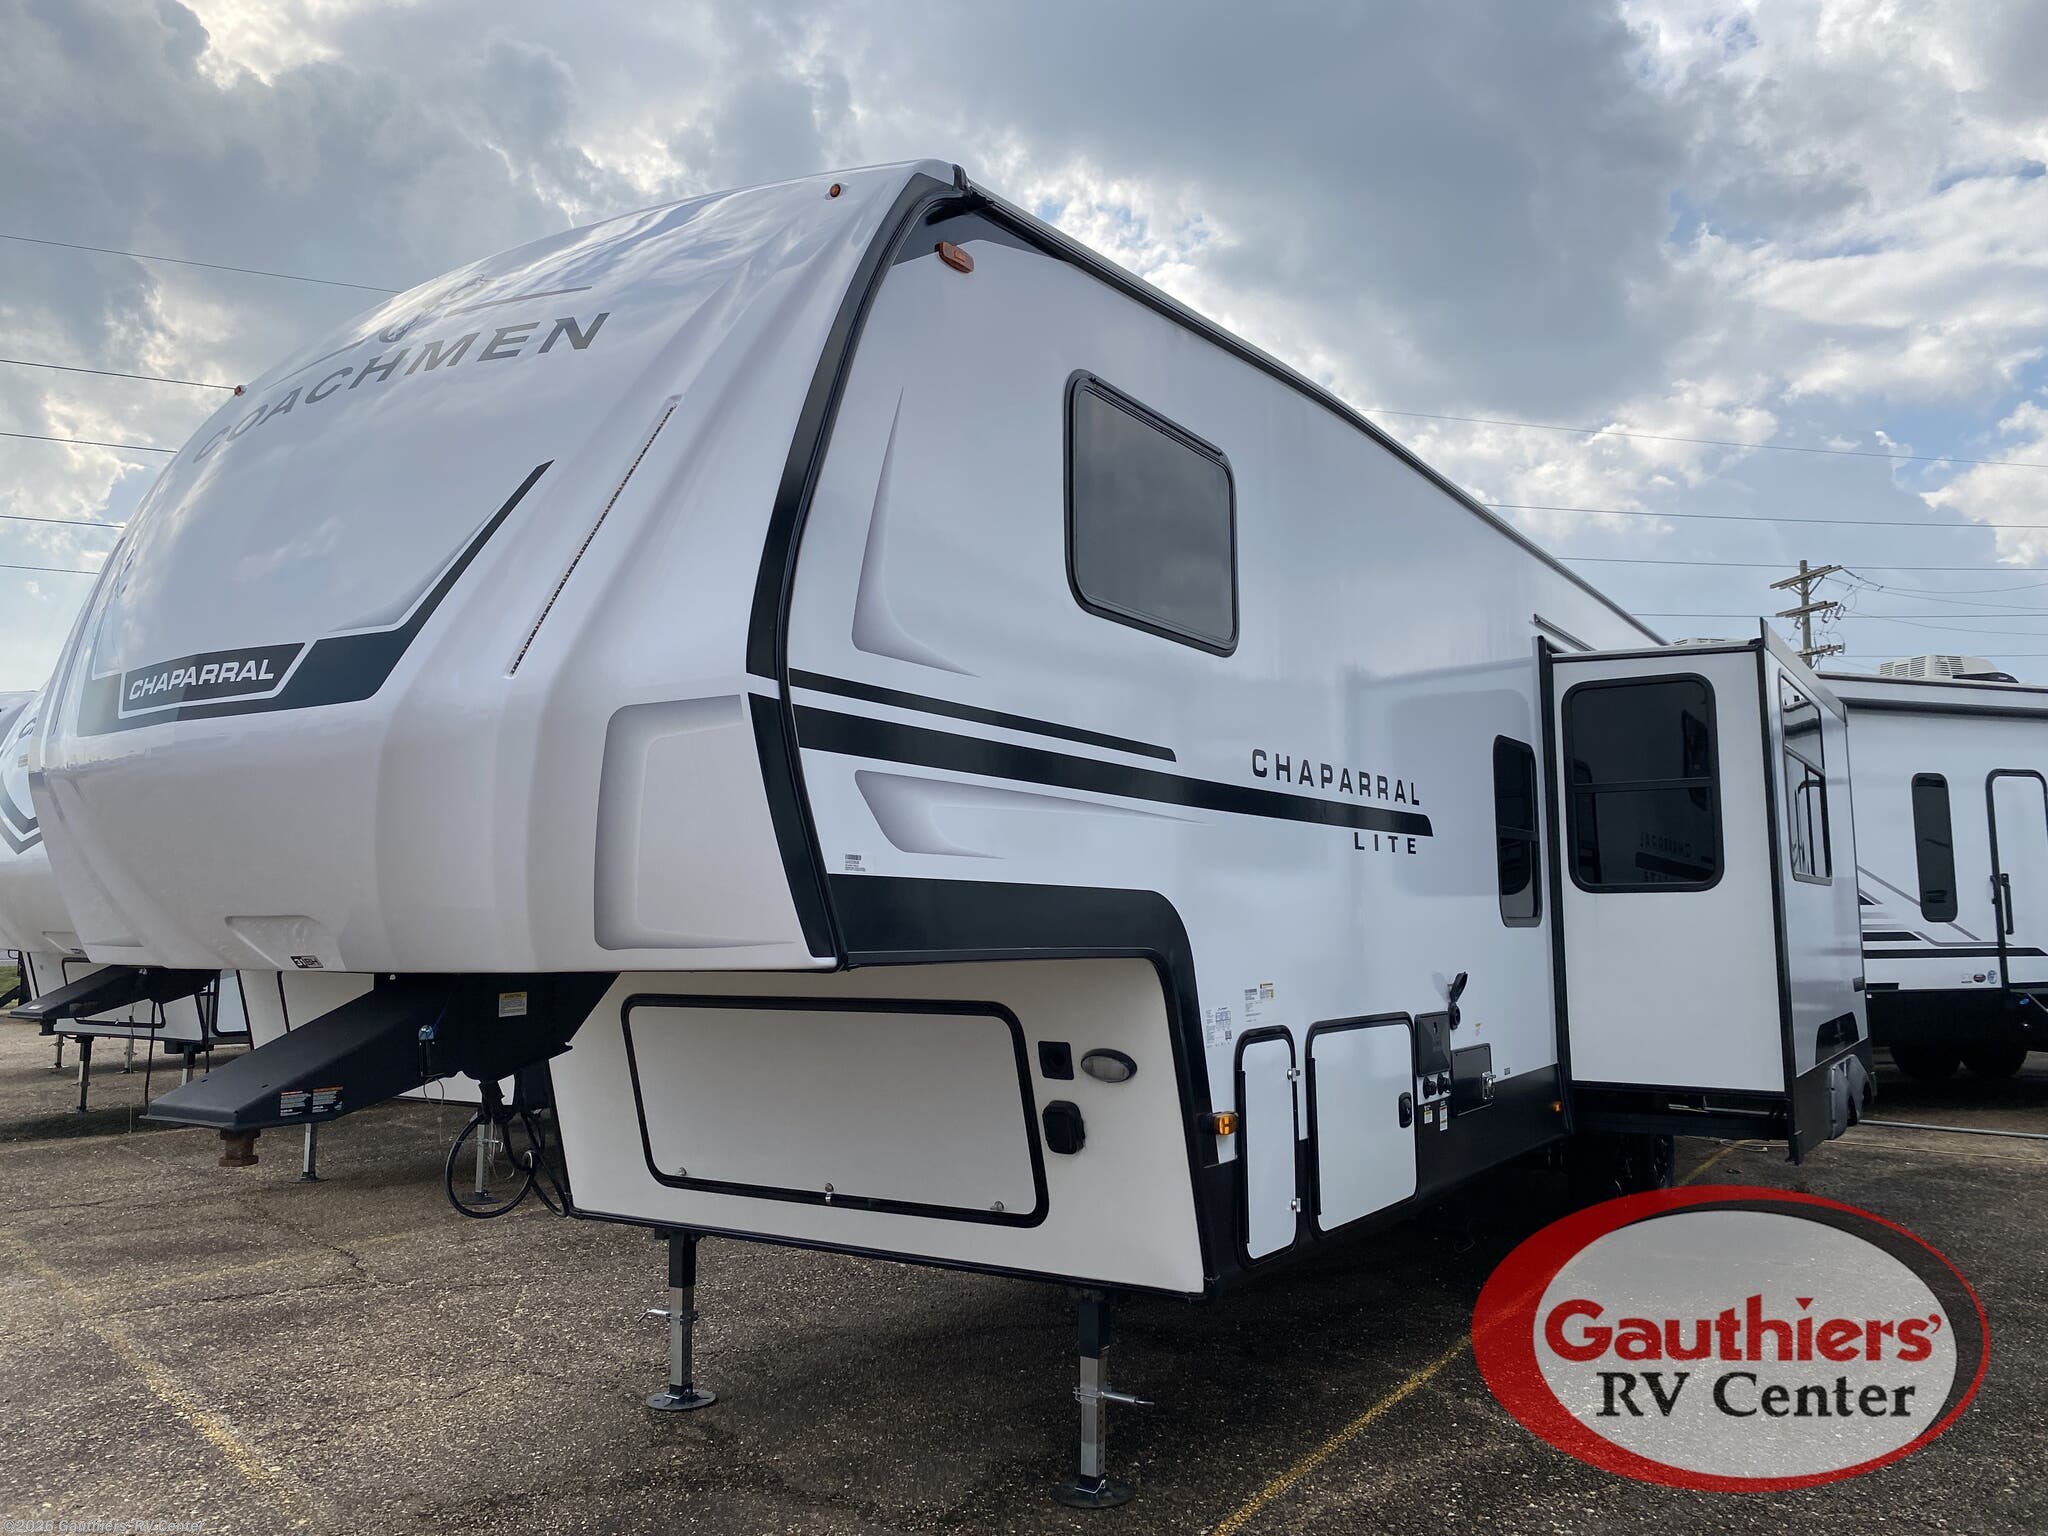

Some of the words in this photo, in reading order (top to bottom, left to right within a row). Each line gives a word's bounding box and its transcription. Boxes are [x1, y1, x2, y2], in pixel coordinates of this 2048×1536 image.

[193, 312, 610, 464] COACHMEN
[128, 658, 275, 701] CHAPARRAL
[1252, 748, 1421, 806] CHAPARRAL
[1353, 831, 1418, 855] LITE
